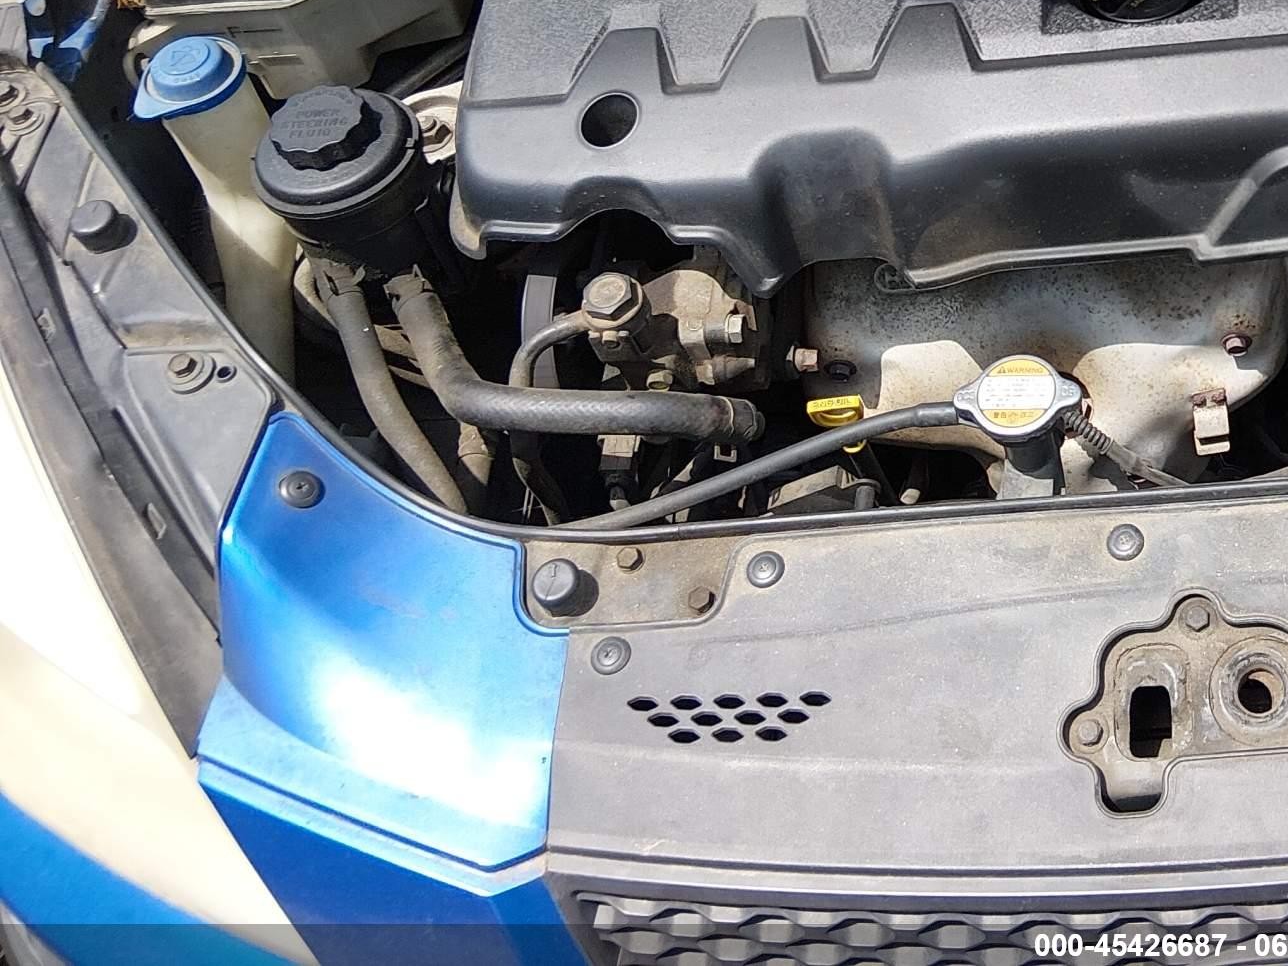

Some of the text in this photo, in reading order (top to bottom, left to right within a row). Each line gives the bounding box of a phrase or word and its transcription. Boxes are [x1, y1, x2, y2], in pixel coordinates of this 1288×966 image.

[296, 108, 341, 118] POWER
[280, 118, 347, 129] STEERING
[289, 128, 332, 139] FLUID
